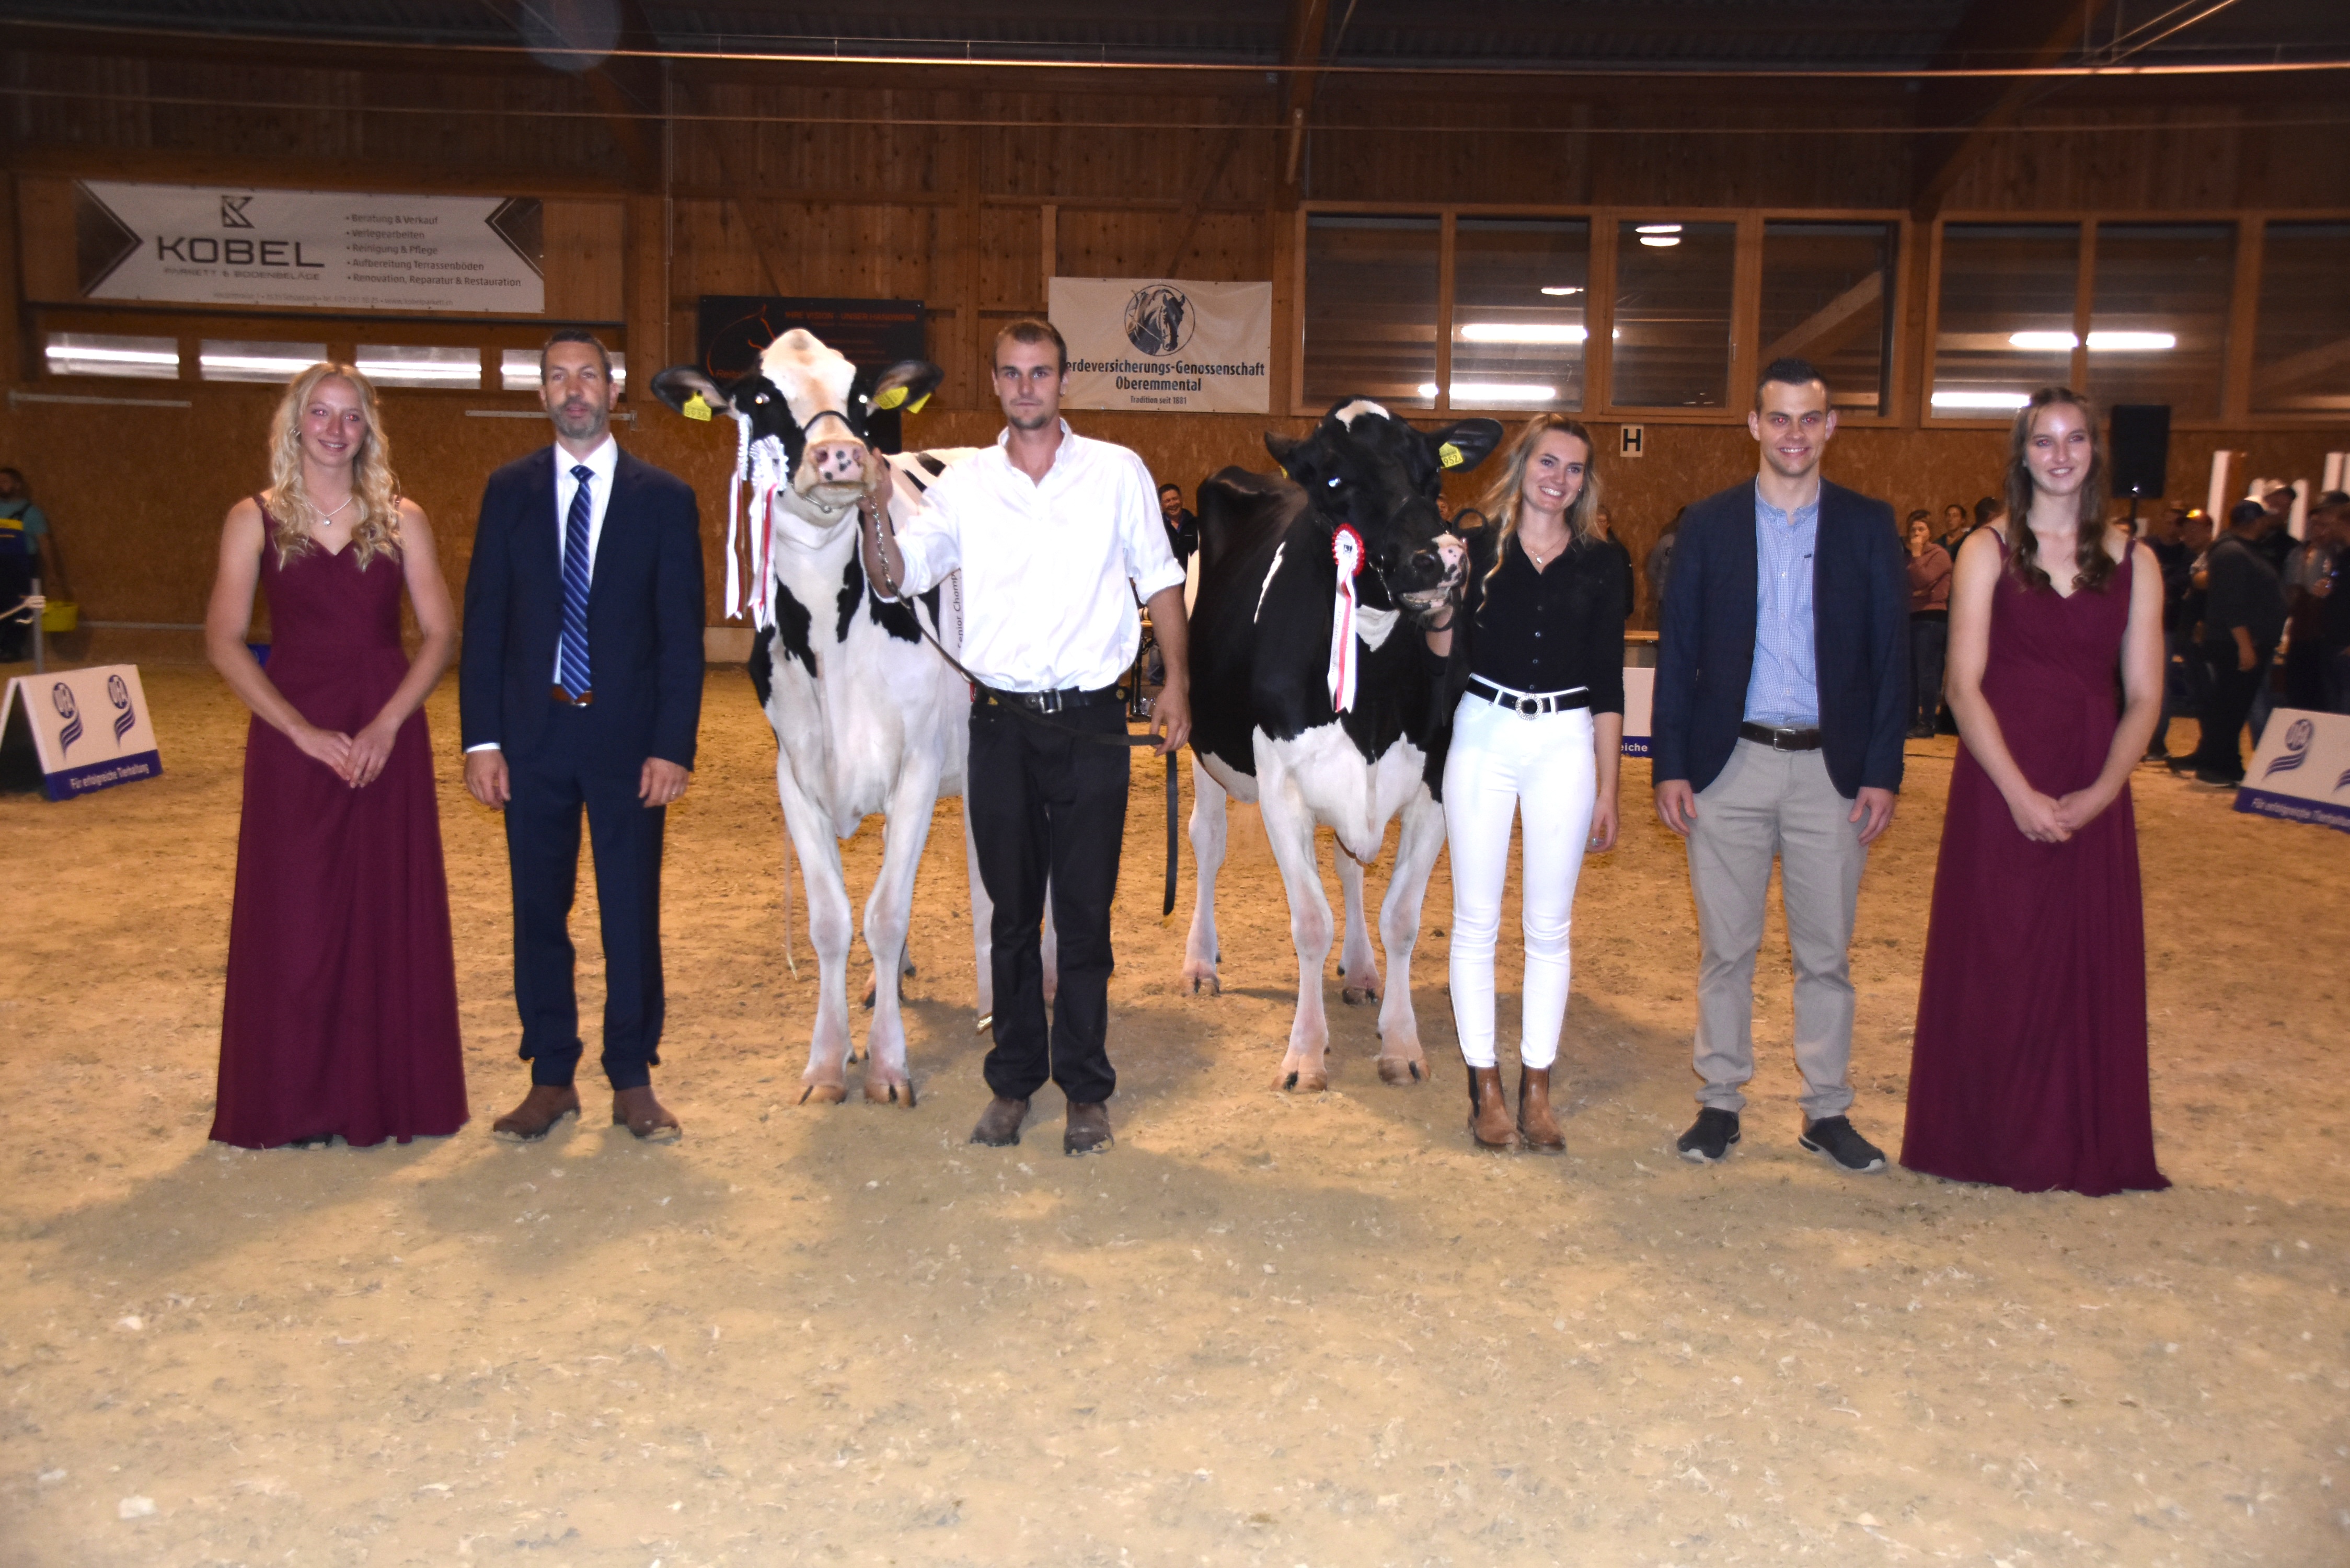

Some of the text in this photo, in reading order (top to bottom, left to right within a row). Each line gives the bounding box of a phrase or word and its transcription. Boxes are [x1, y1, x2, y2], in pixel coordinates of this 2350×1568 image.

[351, 214, 438, 225] Beratung & Verkauf
[352, 229, 425, 239] Verlegearbeiten
[158, 236, 325, 268] KOBEL
[352, 244, 399, 255] Reinigung
[410, 246, 438, 256] Pflege
[353, 259, 412, 270] Aufbereitung
[164, 268, 217, 277] PARKETT
[353, 274, 407, 284] Renovation,
[410, 275, 453, 285] Reparatur
[465, 278, 521, 286] Restauration
[806, 311, 834, 320] VISION
[1067, 359, 1264, 376] erdeversicherungs-Genossenschaft
[1115, 377, 1202, 391] Oberemmental
[1130, 396, 1158, 404] Tradition
[1623, 429, 1641, 452] H
[950, 574, 961, 612] Champ
